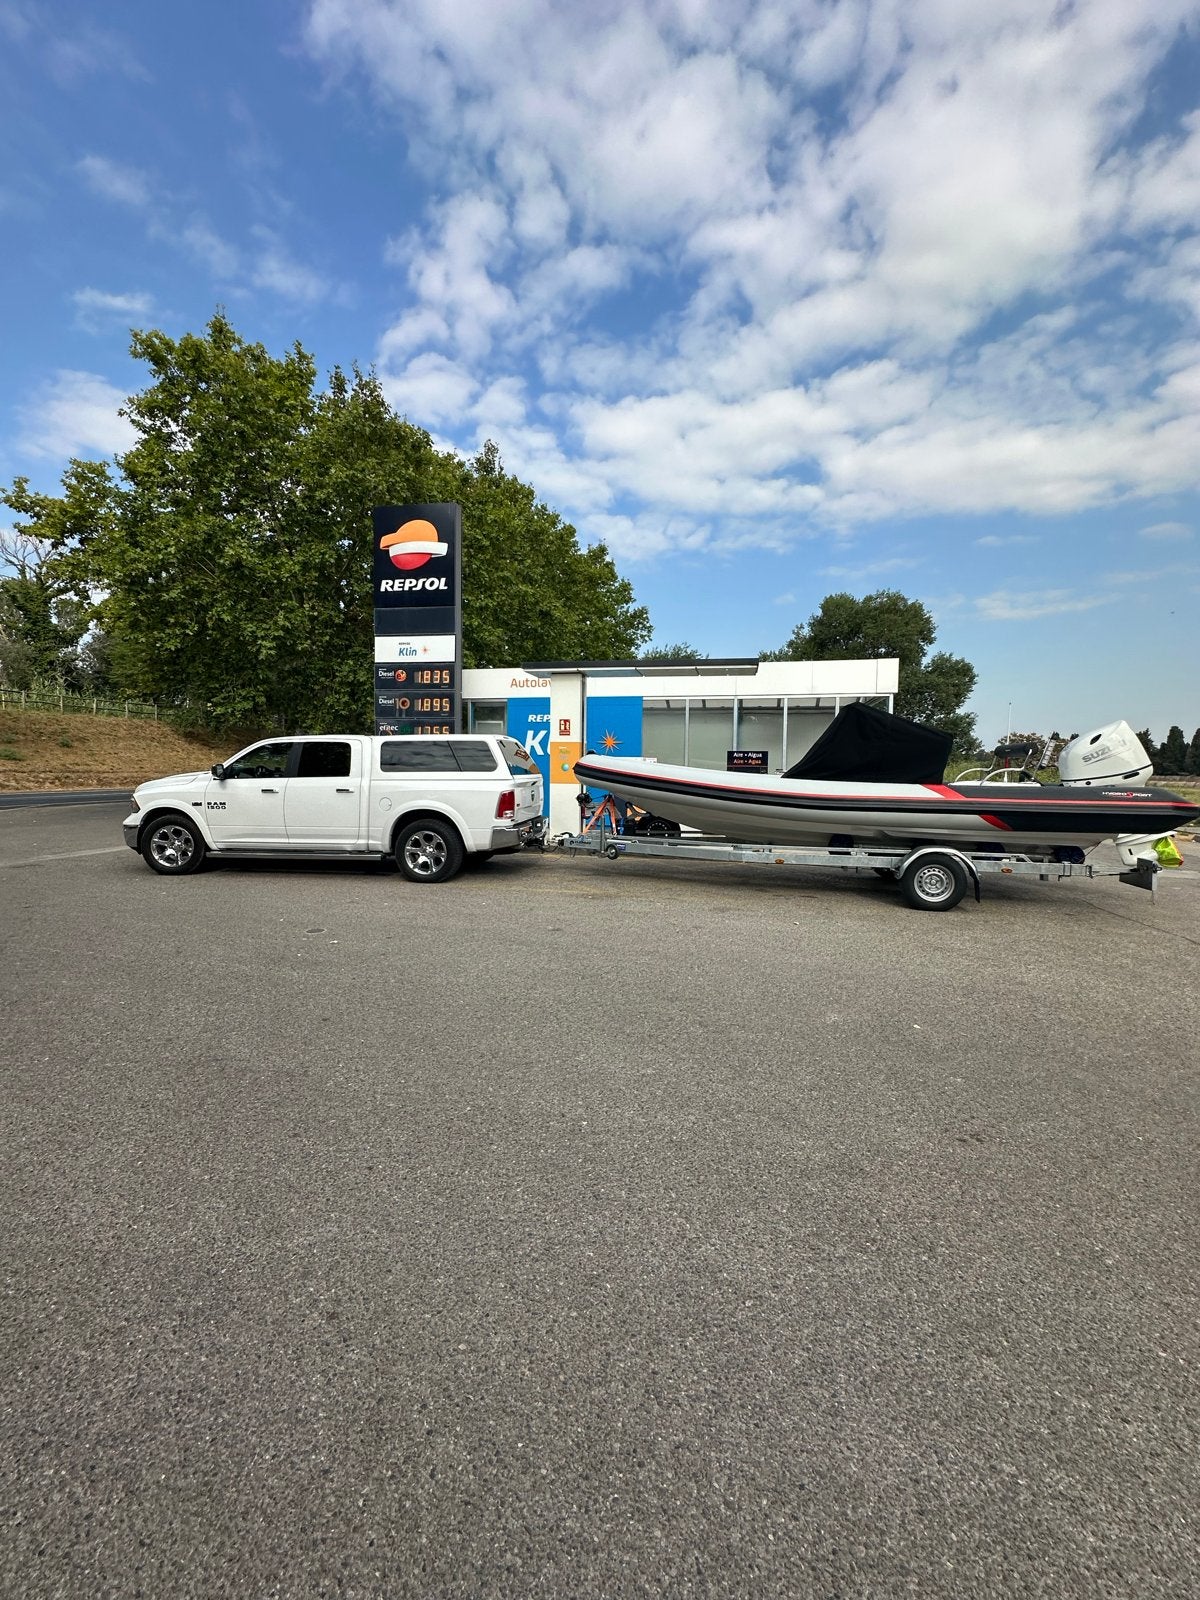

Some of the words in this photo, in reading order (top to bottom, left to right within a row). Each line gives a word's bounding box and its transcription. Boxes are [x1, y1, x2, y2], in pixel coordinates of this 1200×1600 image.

[380, 577, 448, 592] REPSOL
[398, 647, 417, 657] Klin
[528, 714, 551, 723] REP
[1081, 738, 1128, 763] SUZI
